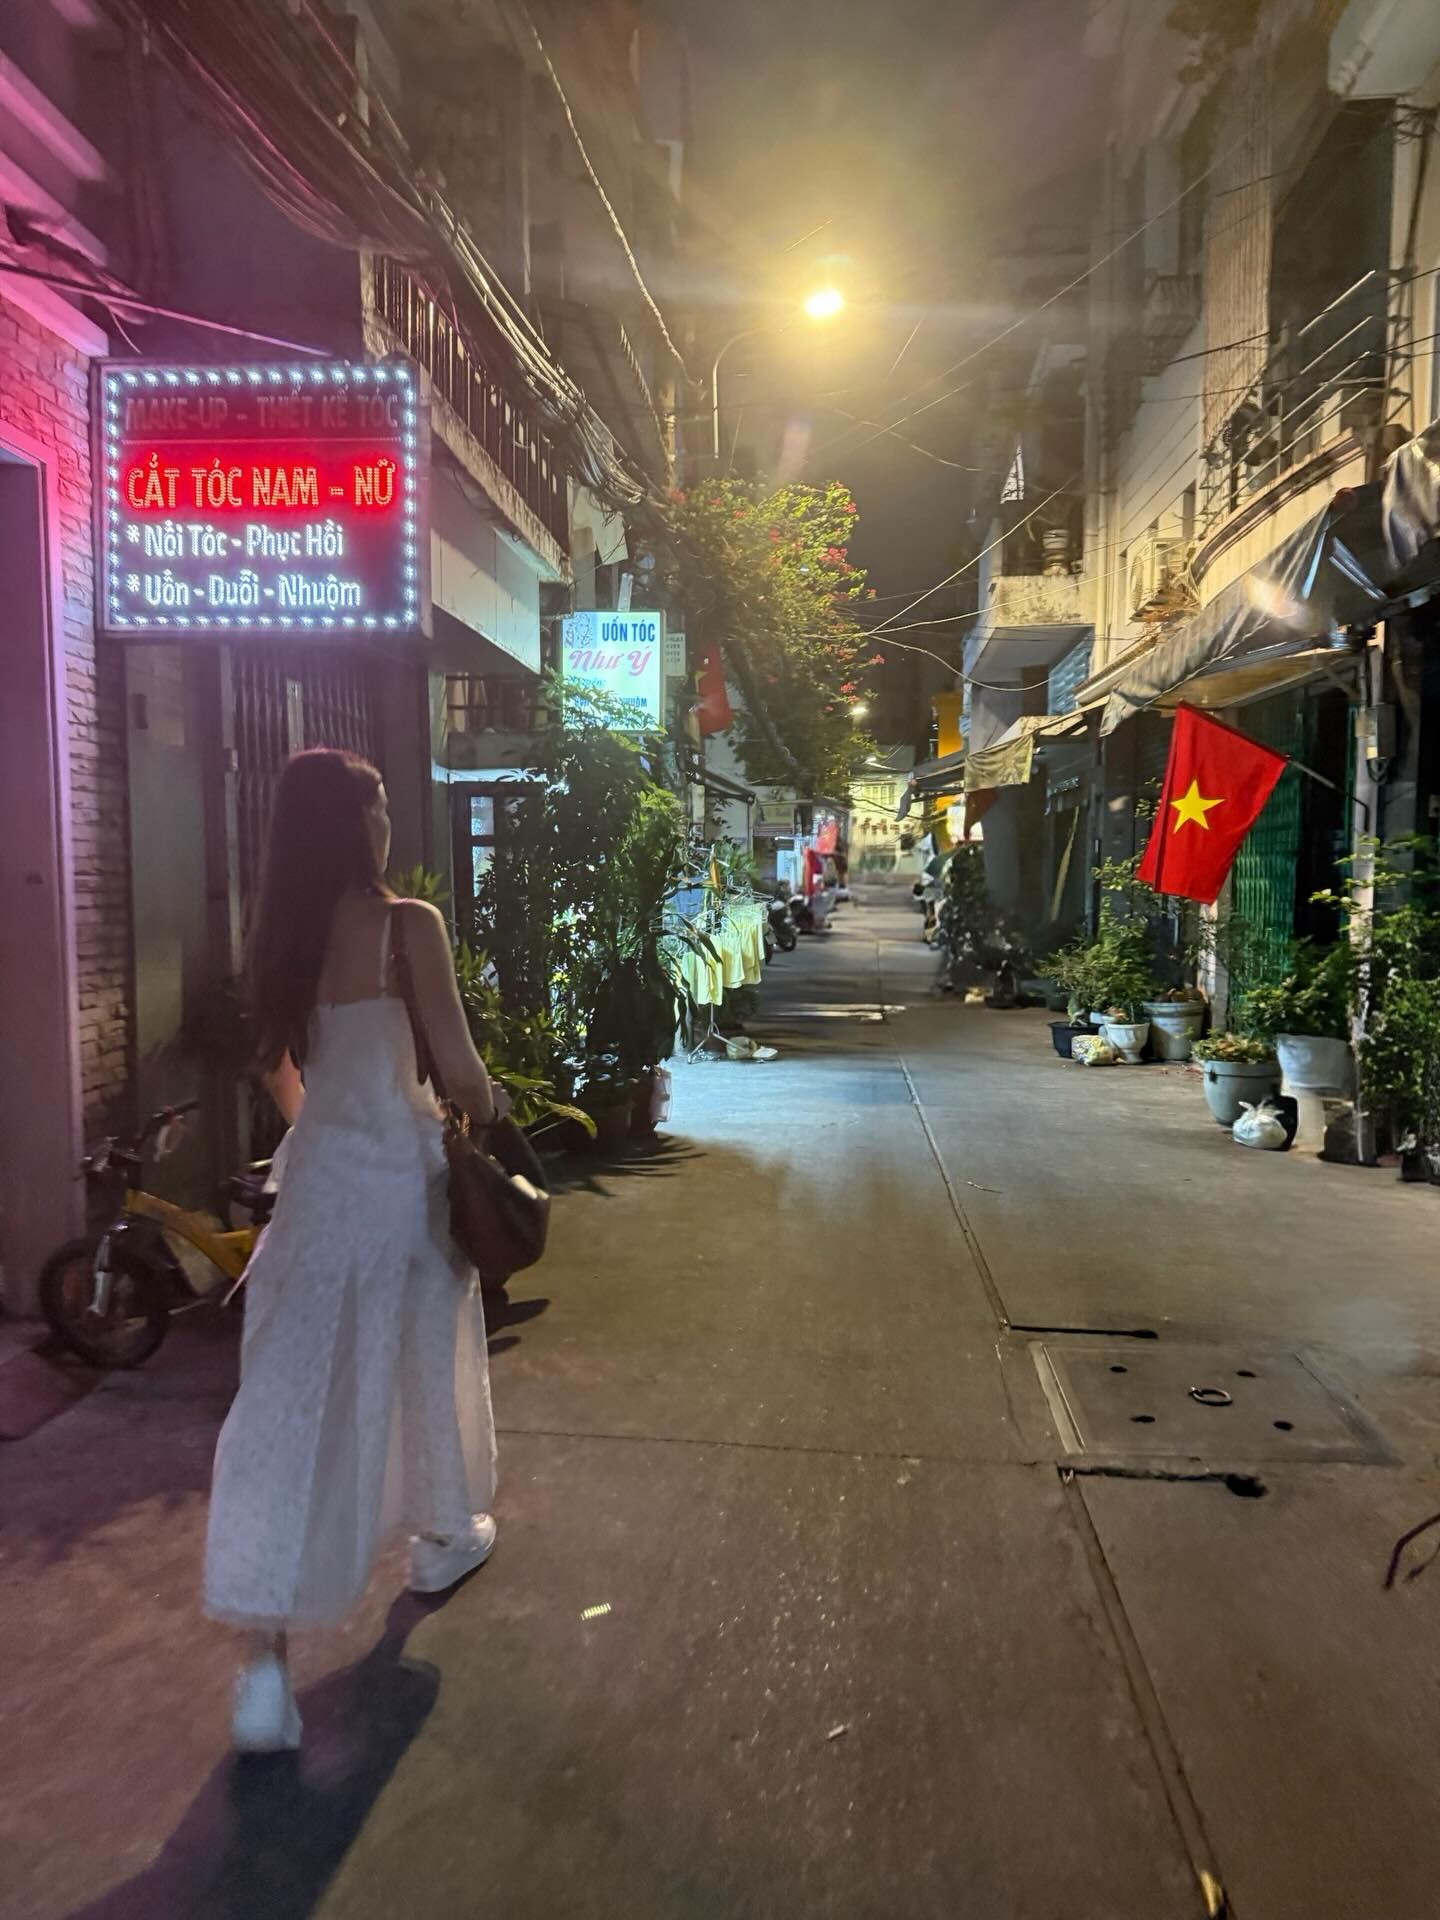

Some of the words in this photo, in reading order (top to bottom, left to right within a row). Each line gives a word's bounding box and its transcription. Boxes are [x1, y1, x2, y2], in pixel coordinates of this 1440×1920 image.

[125, 397, 228, 431] MAKE-UP
[358, 388, 399, 428] TÓC
[191, 458, 242, 508] TÓC
[251, 466, 320, 507] NAM
[353, 457, 397, 507] NỮ
[186, 524, 227, 557] Tóc
[245, 524, 301, 562] Phục
[305, 519, 344, 557] Hồi
[277, 574, 361, 611] Nhuộm
[602, 616, 628, 642] UỐN
[632, 619, 656, 642] TÓC
[568, 650, 624, 672] Như
[626, 646, 653, 676] Ý
